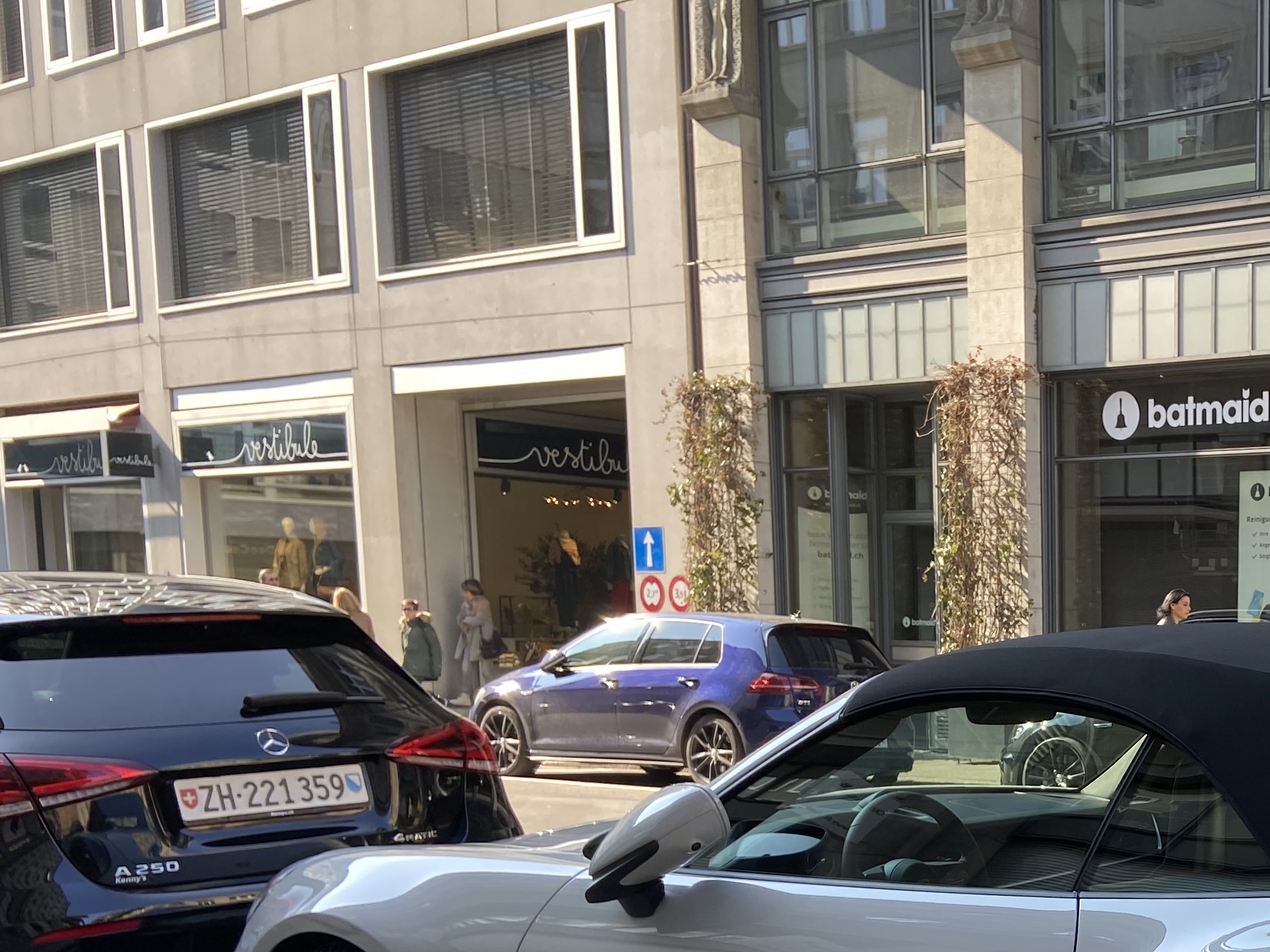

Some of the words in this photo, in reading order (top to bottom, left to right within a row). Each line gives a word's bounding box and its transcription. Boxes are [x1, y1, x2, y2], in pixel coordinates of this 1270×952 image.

[1148, 388, 1270, 428] batmaid
[48, 439, 103, 474] vestibu
[240, 420, 322, 462] vestibule
[527, 438, 630, 475] vestibu
[115, 865, 132, 877] A
[135, 861, 180, 876] 250
